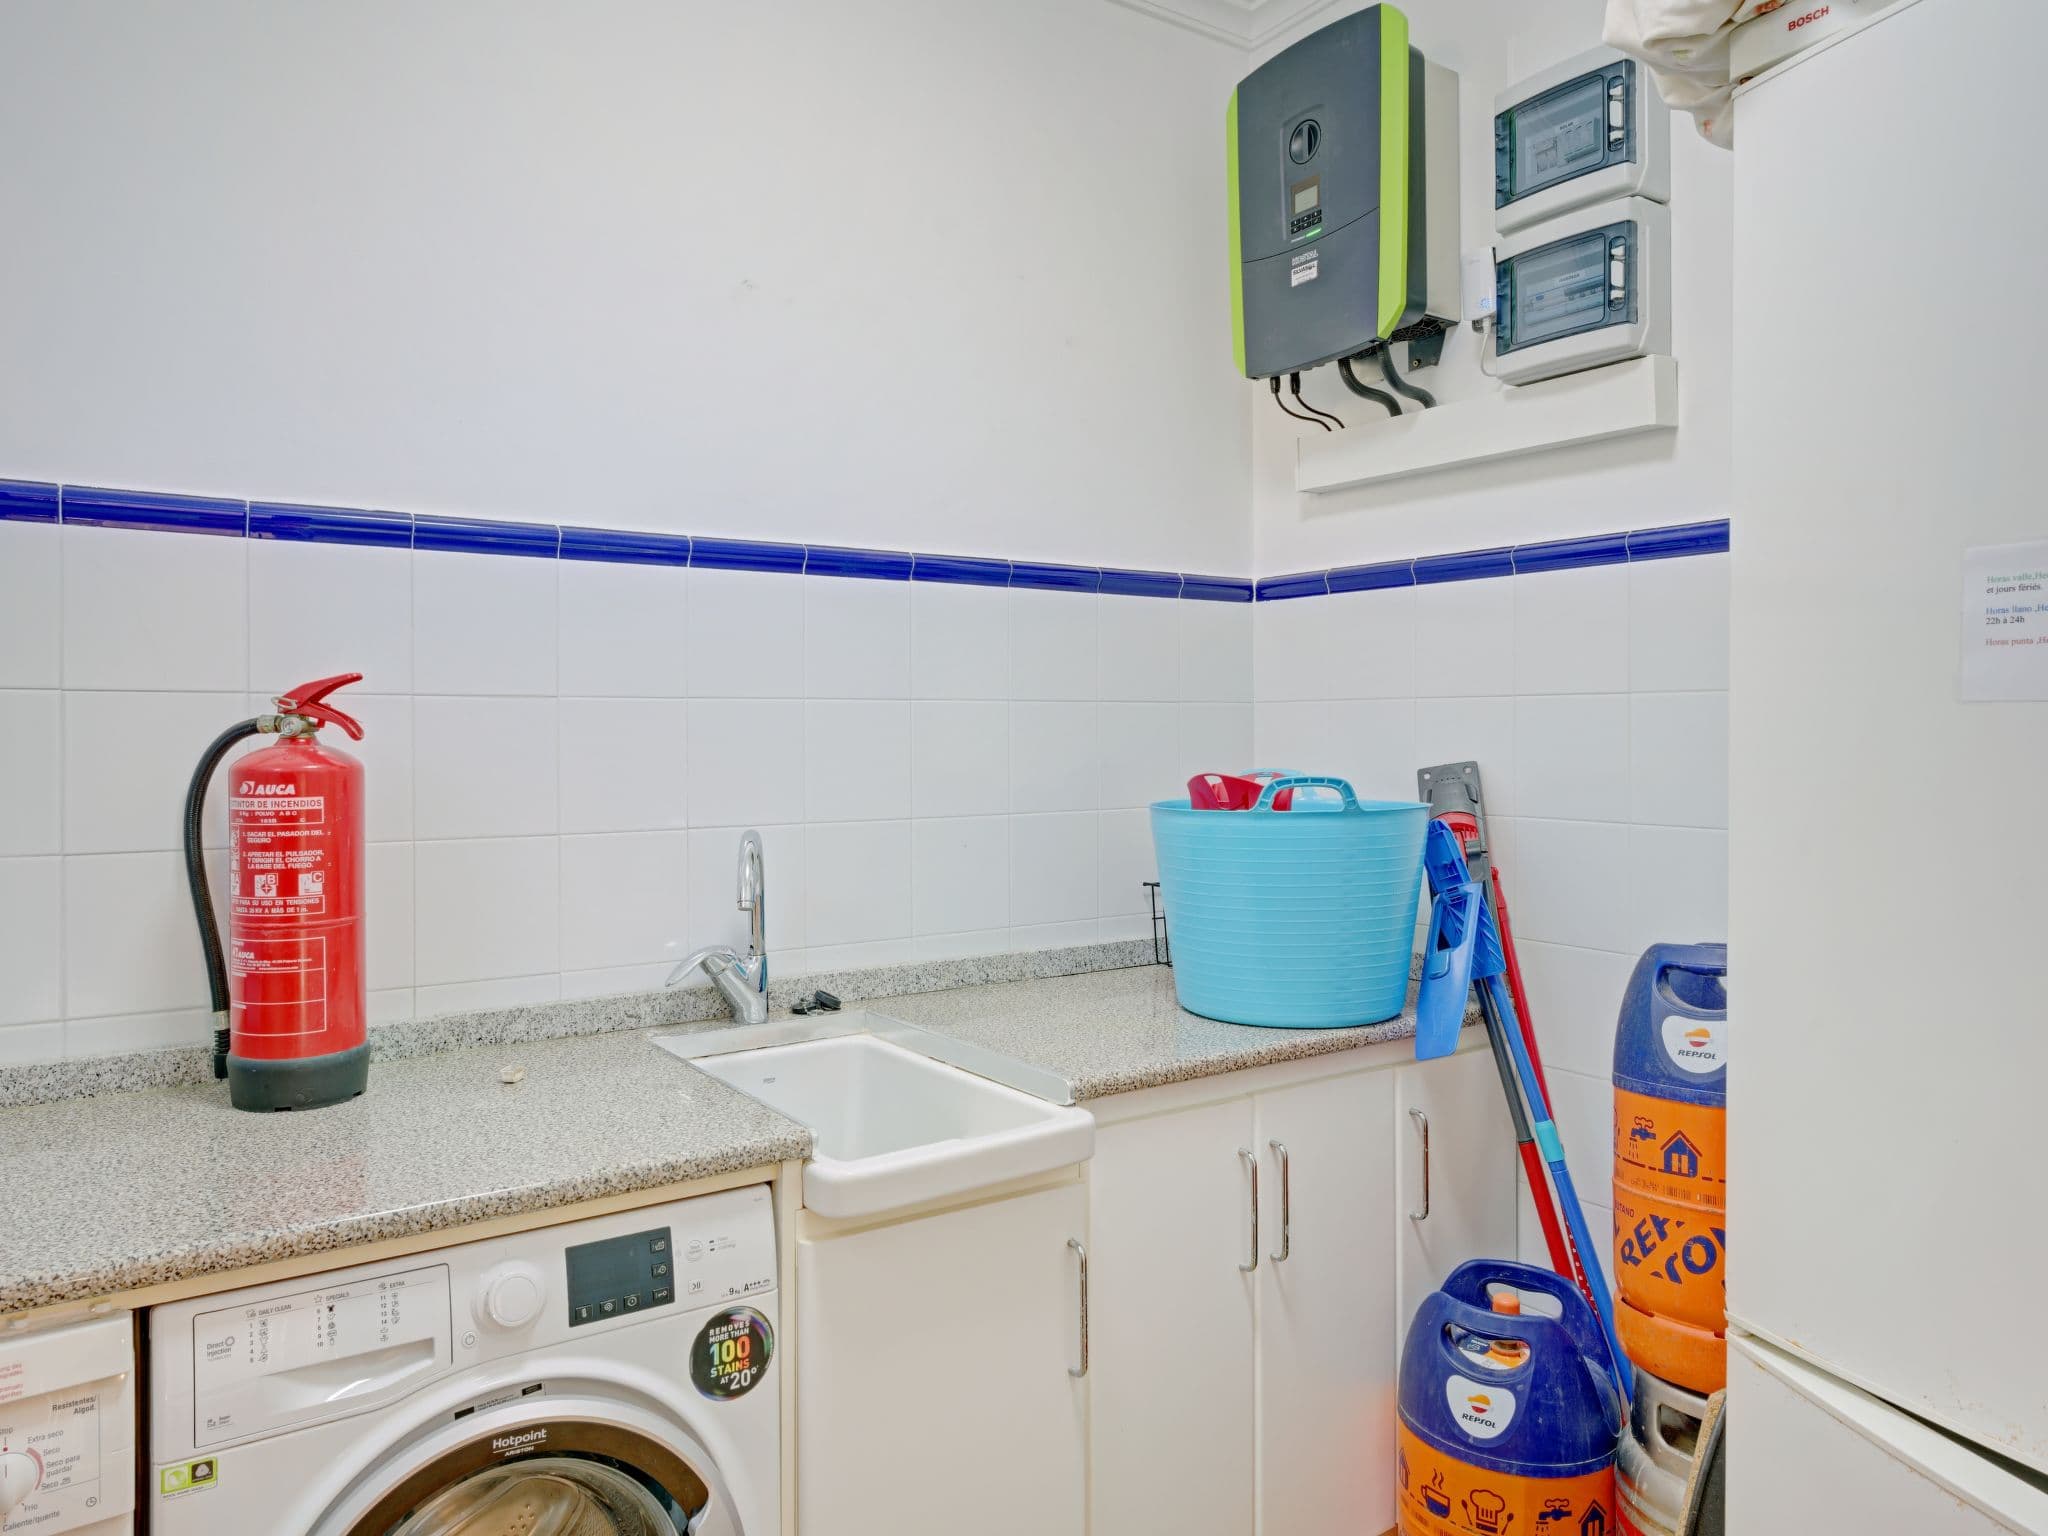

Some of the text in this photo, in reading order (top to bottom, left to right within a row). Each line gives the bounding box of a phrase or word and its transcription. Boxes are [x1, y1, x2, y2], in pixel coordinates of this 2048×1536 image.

[1787, 6, 1829, 31] BOSCH
[1995, 585, 2017, 595] jours
[1985, 617, 2001, 625] 22h
[2009, 615, 2025, 624] 24h
[254, 784, 296, 796] AUCA
[271, 800, 322, 808] INCENDIOS
[267, 875, 276, 885] B
[313, 873, 323, 882] C
[1677, 1050, 1717, 1062] REPSOL
[729, 1287, 735, 1296] 9
[709, 1319, 751, 1337] REMOVES
[709, 1328, 750, 1344] MORE THAN
[207, 1341, 225, 1350] Direct
[709, 1335, 751, 1366] 100
[207, 1347, 232, 1358] Injection
[710, 1358, 750, 1378] STAINS
[720, 1376, 730, 1385] AT
[1461, 1413, 1497, 1429] REPSOL
[27, 1430, 65, 1445] Extra seco
[493, 1428, 547, 1450] Hotpoint
[504, 1446, 534, 1457] ARISTON
[46, 1455, 81, 1470] Seco para
[41, 1480, 59, 1491] Seco
